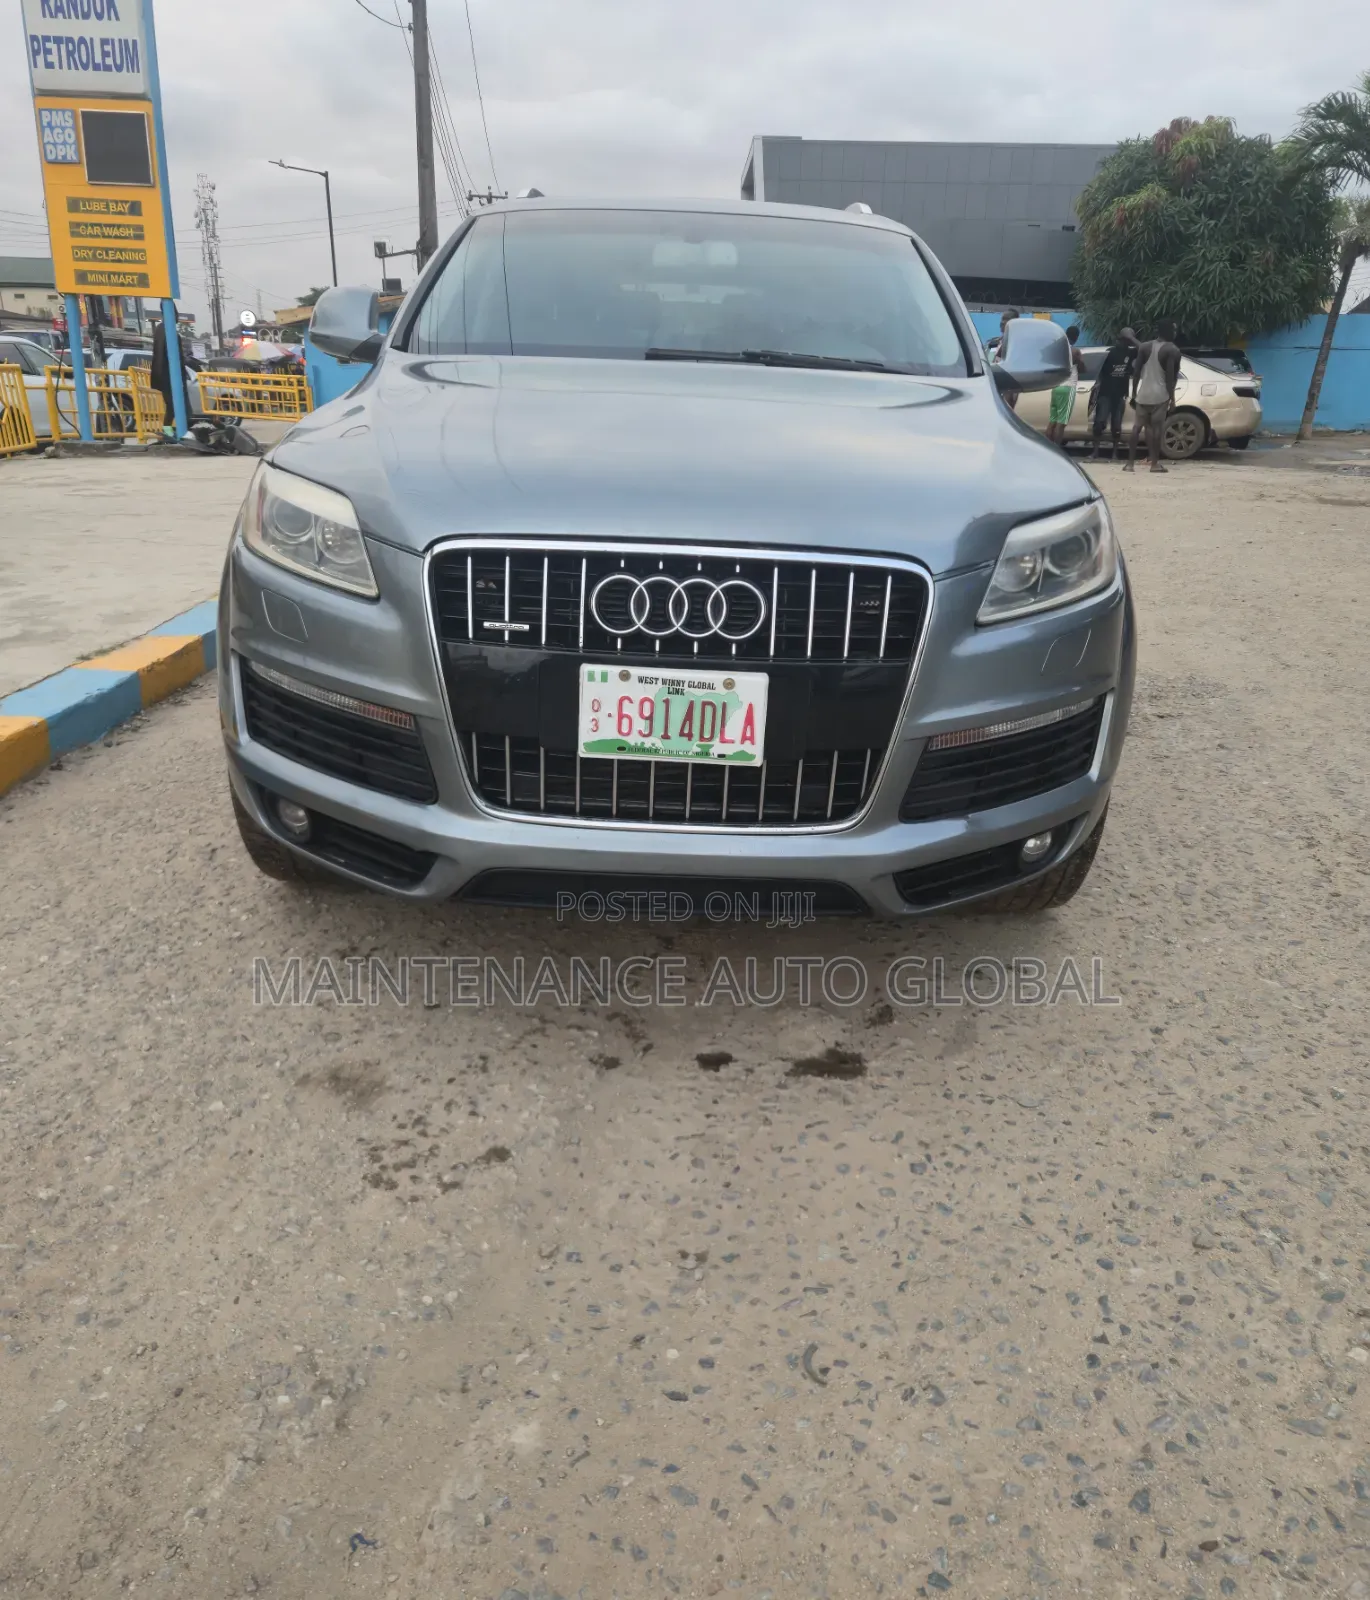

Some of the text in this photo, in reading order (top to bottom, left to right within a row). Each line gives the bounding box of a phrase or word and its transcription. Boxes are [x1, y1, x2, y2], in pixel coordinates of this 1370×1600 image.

[29, 34, 140, 73] PETROLEUM
[41, 110, 73, 127] PMS
[43, 127, 76, 143] AGO
[46, 143, 77, 160] DPK
[80, 201, 130, 212] LUBE BAY
[79, 225, 133, 237] CAR WASH
[73, 249, 146, 261] DRY CLEANING
[87, 273, 138, 284] MINI MART
[637, 675, 716, 690] WEST WINNY GLOBAL
[667, 686, 685, 696] LINK
